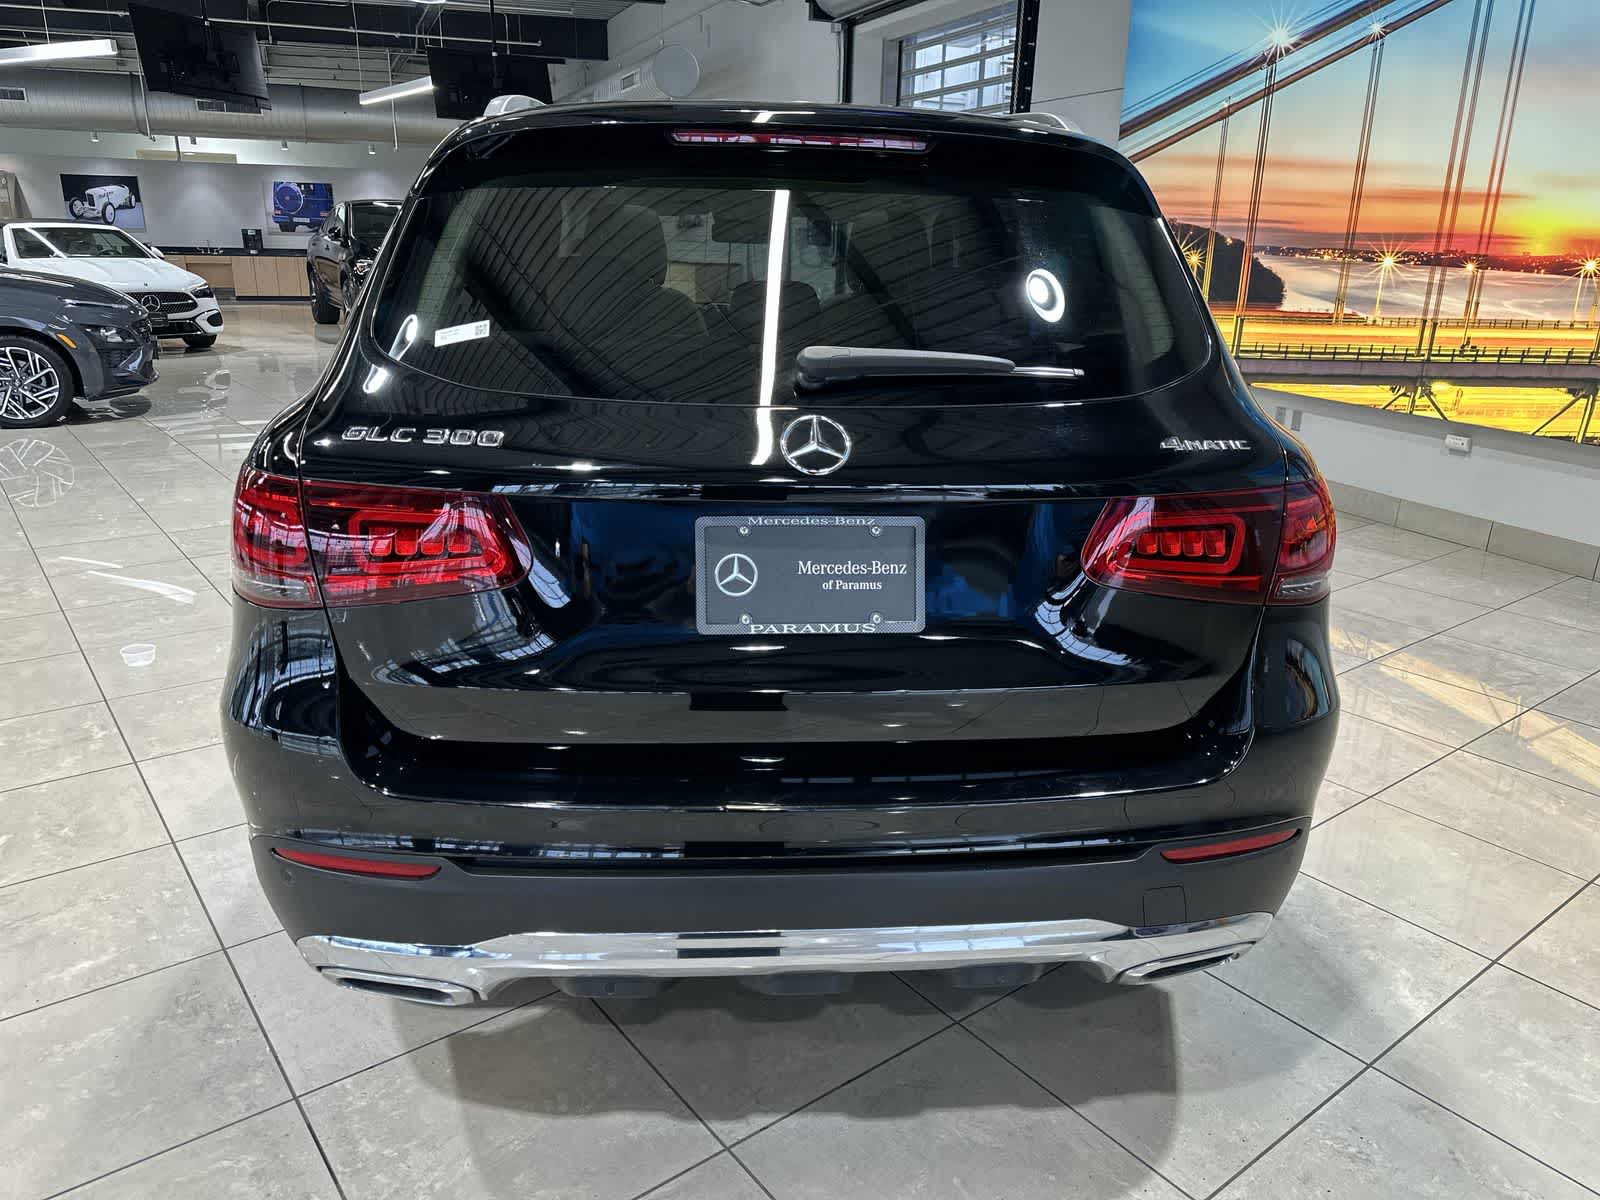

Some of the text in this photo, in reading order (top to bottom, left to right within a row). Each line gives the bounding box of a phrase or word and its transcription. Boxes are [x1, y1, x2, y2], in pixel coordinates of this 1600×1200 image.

[341, 426, 504, 447] GLC 300
[1160, 436, 1251, 451] 4MATIC
[748, 516, 876, 526] Mercedes-Benz
[798, 560, 907, 575] Mercedes-Benz
[822, 580, 882, 590] of Paramus
[750, 623, 876, 634] PARAMUS
